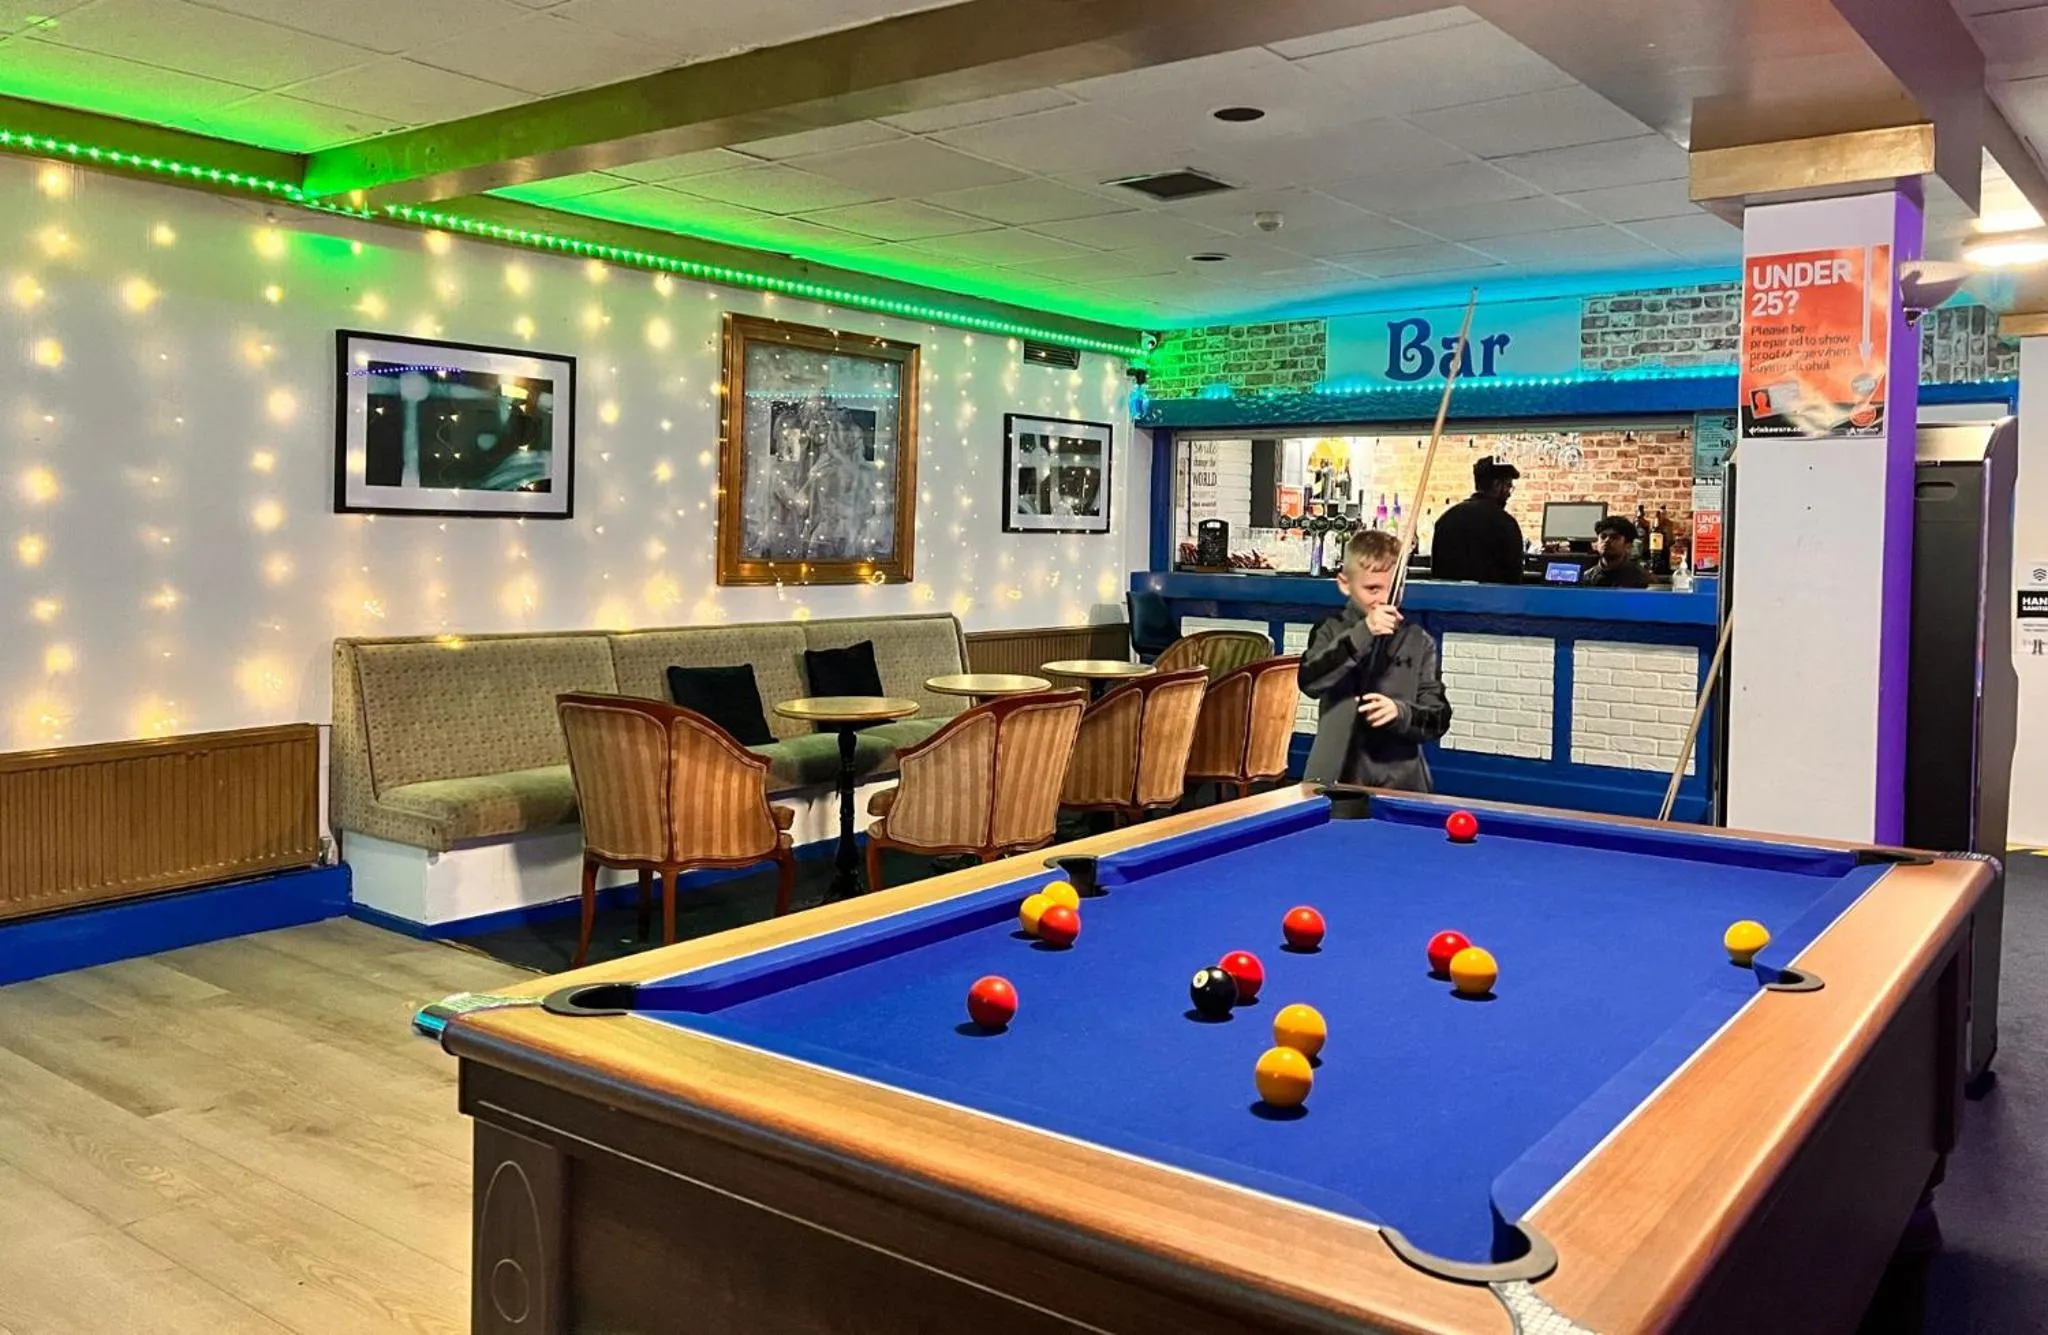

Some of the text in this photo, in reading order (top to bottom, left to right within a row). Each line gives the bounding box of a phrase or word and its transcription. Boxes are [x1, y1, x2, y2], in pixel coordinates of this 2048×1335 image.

[1752, 258, 1853, 290] UNDER
[1751, 289, 1800, 317] 25?
[1751, 324, 1805, 336] Please be
[1384, 317, 1511, 381] Bar
[1750, 335, 1850, 350] prepared to show
[1750, 349, 1779, 361] proof
[1192, 472, 1218, 487] WORLD
[1697, 514, 1721, 524] UND
